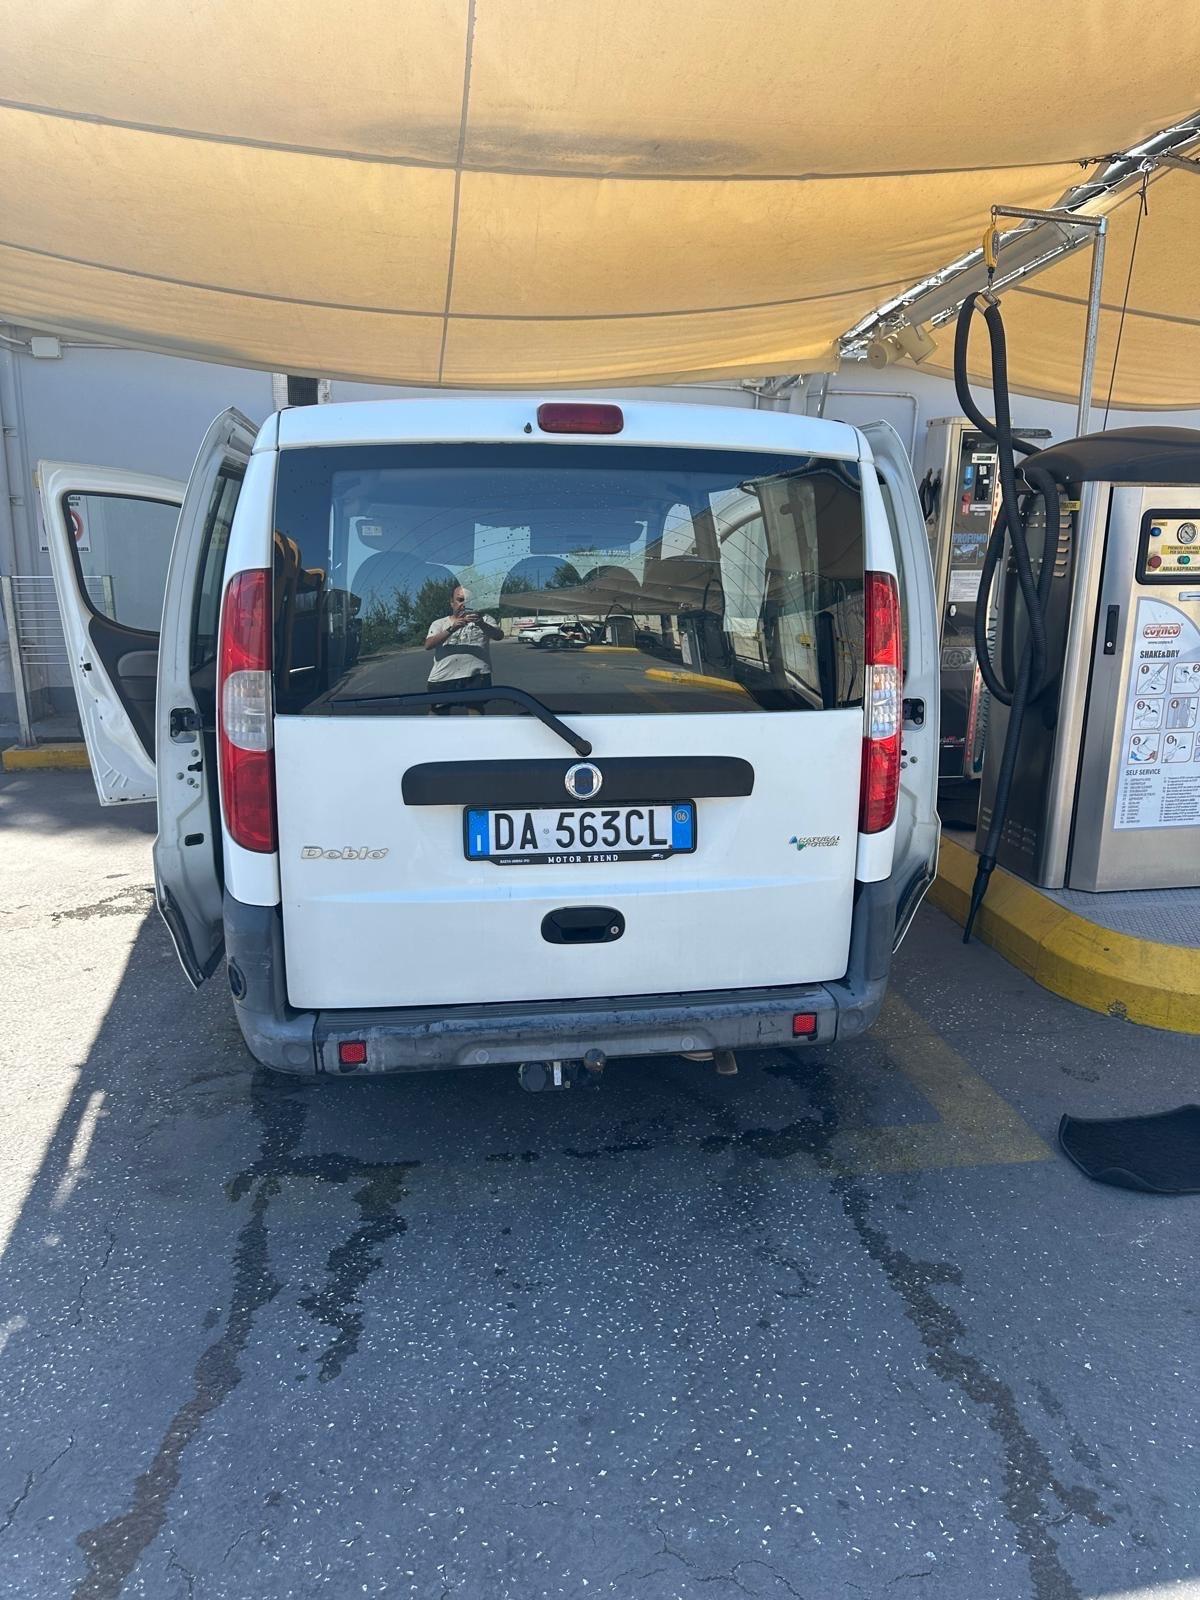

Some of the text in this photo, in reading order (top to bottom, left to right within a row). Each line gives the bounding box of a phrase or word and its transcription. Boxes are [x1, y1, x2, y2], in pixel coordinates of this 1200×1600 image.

[1139, 650, 1180, 659] SHAKE&DRY
[494, 812, 538, 851] DA
[556, 809, 668, 849] 563CL
[676, 812, 687, 821] 06
[587, 854, 618, 862] TREND
